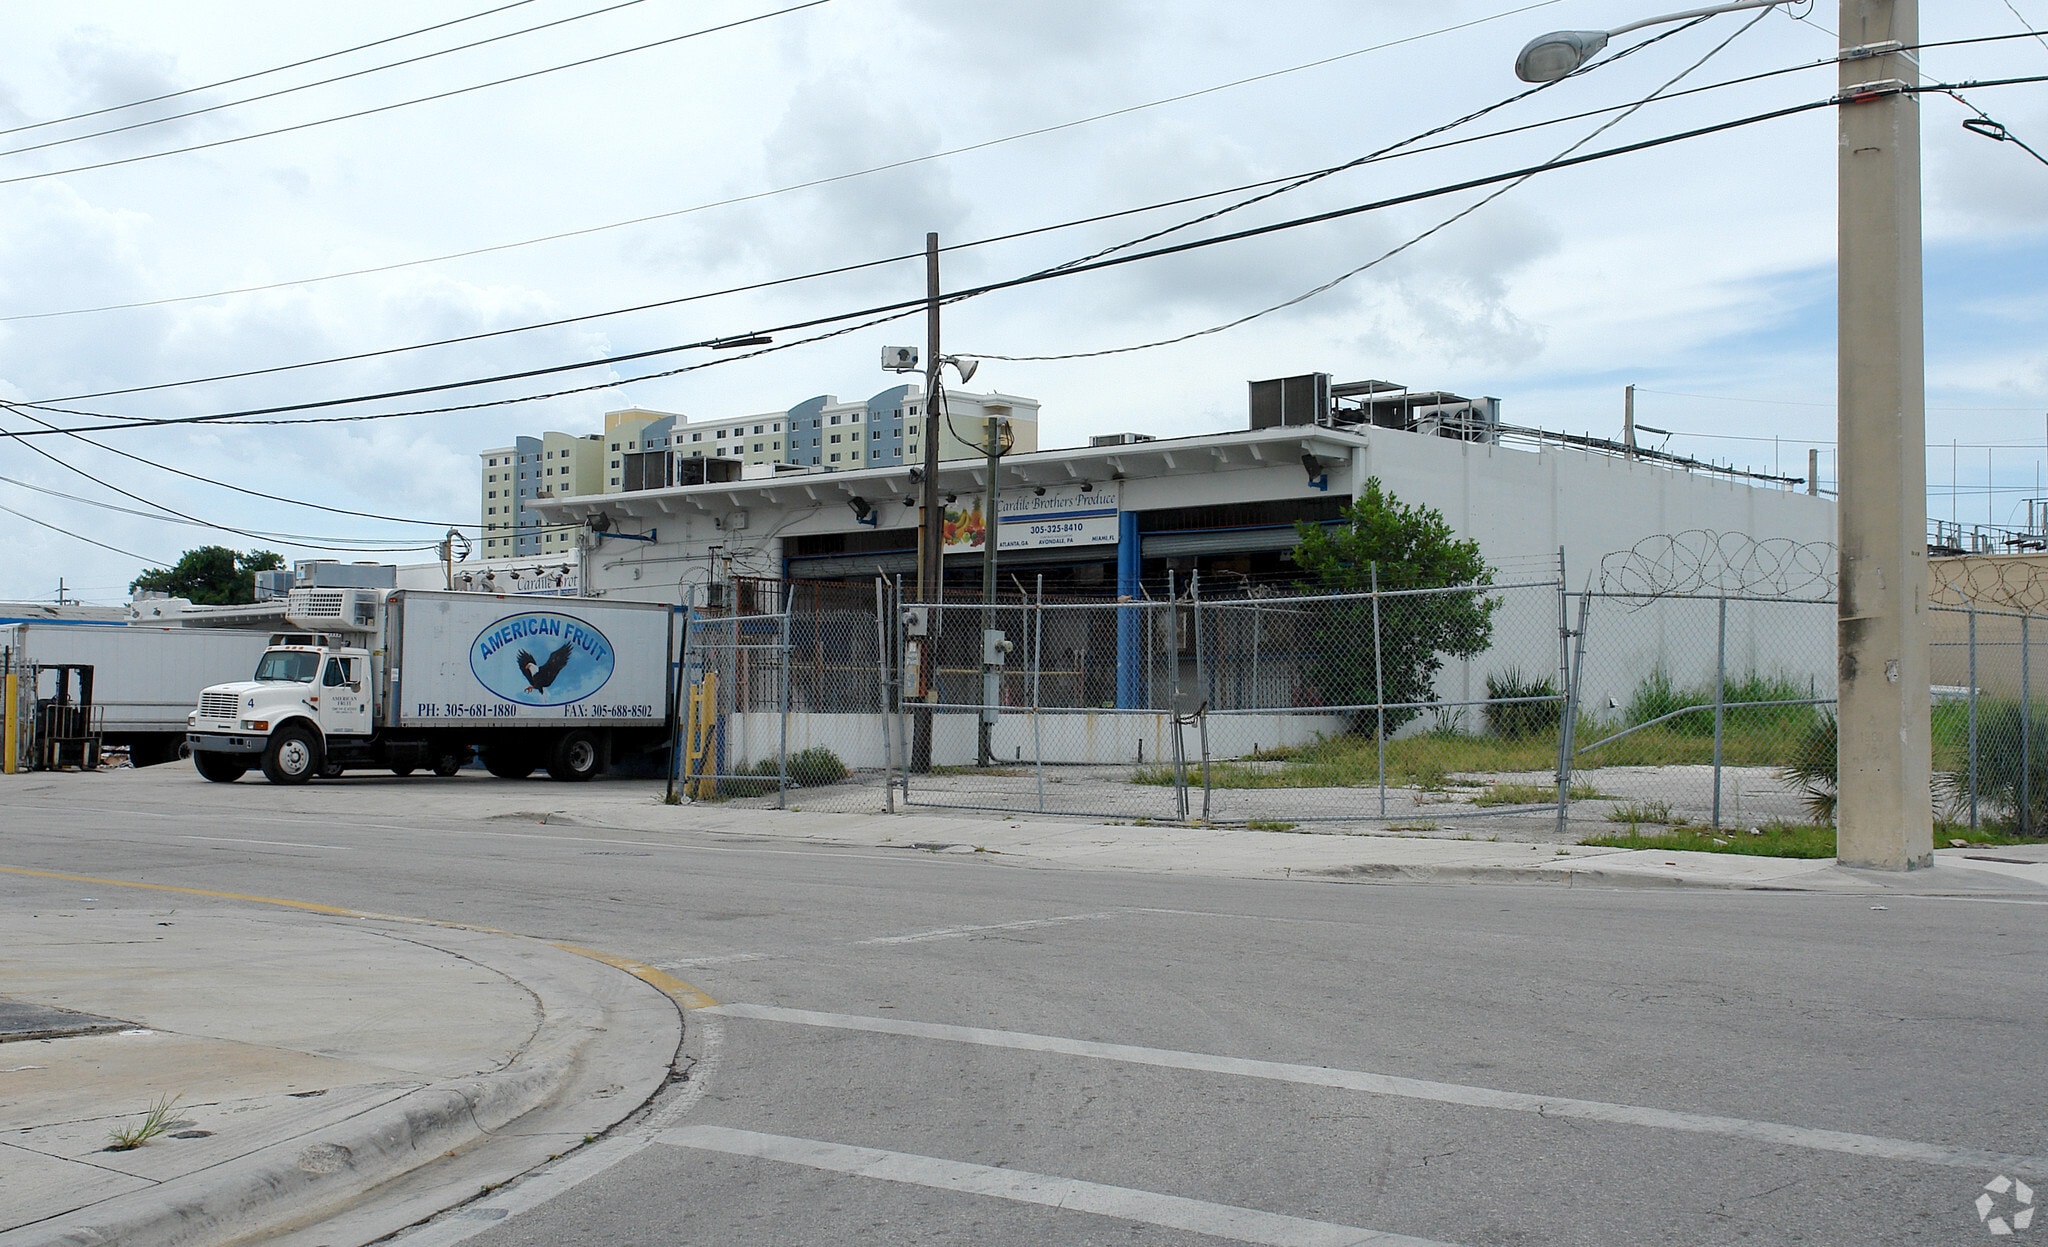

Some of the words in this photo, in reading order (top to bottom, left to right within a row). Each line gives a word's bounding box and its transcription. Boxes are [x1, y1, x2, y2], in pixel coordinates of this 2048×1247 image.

[1032, 493, 1073, 509] Brothers
[1076, 490, 1115, 506] Produce
[1030, 523, 1083, 534] 305-325-8410
[480, 618, 561, 661] AMERICAN
[564, 623, 607, 661] FRUIT
[247, 698, 254, 708] 4
[418, 703, 439, 717] PH:
[444, 703, 517, 717] 305-681-1880
[564, 704, 588, 717] FAX:
[591, 704, 652, 717] 305-688-8502
